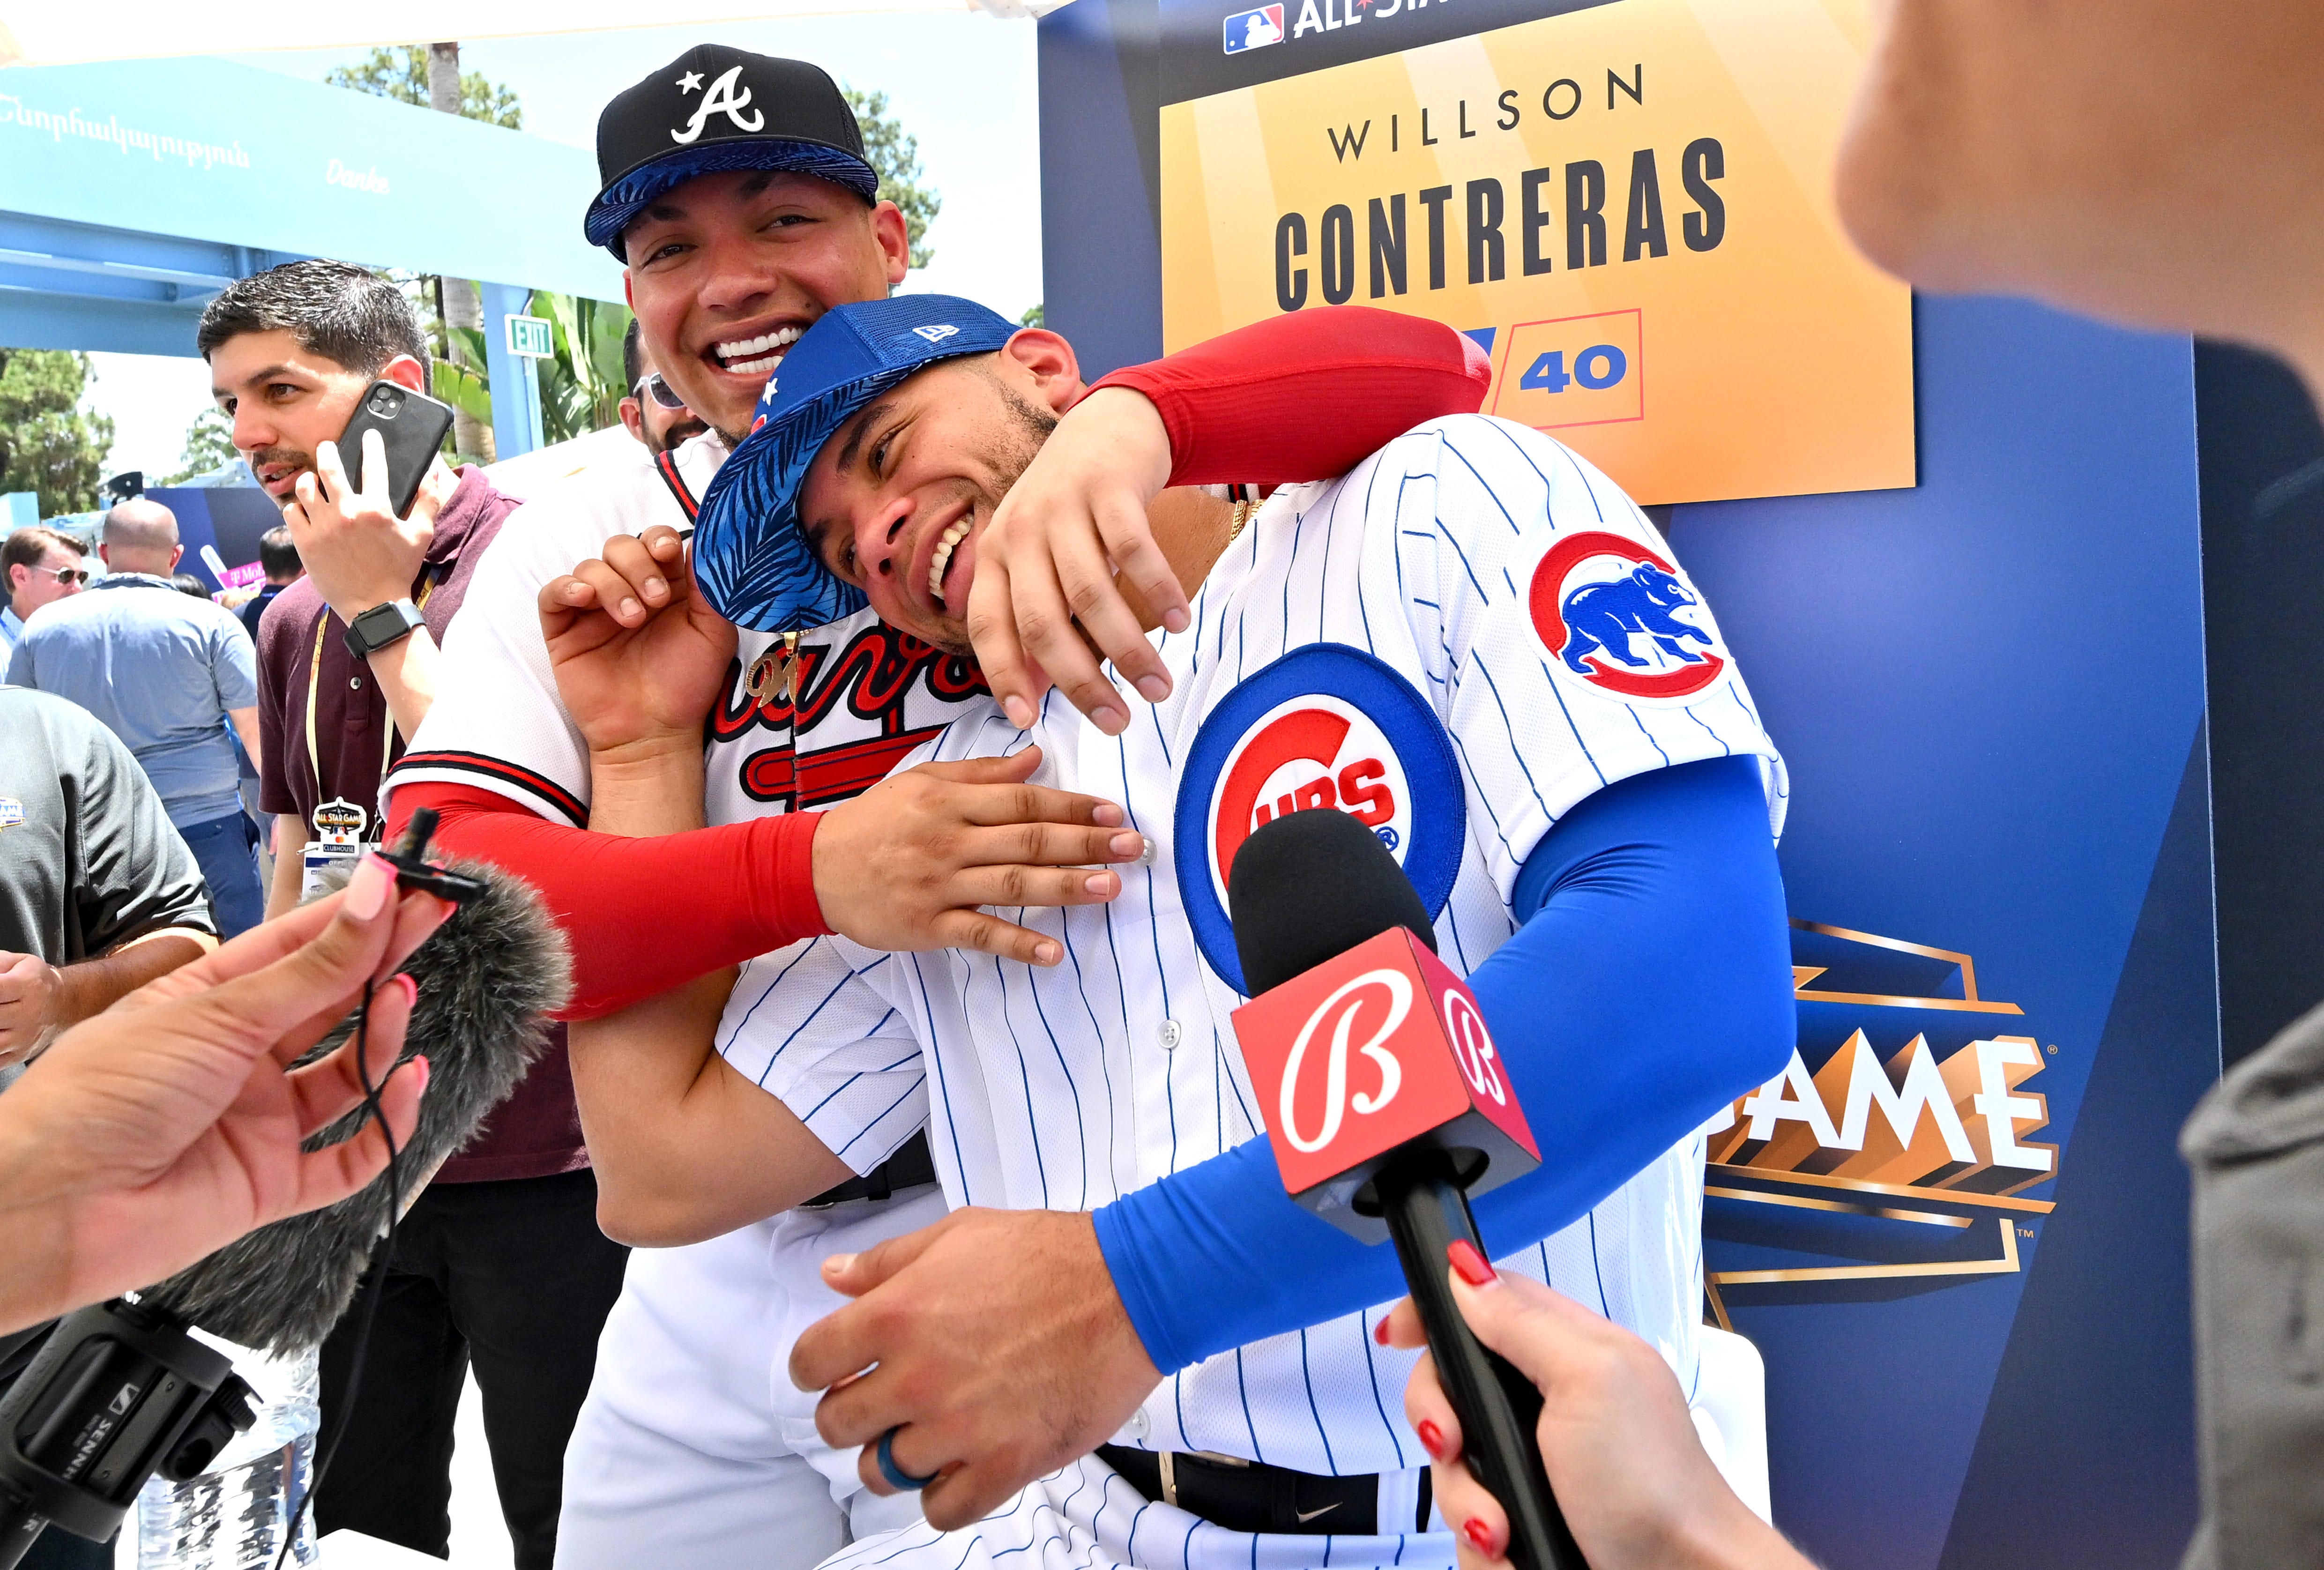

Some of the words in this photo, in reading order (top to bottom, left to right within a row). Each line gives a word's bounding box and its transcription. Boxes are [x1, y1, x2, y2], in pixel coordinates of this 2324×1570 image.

[1327, 63, 1643, 164] WILLSON
[327, 159, 391, 195] Danke
[1275, 137, 1726, 312] CONTRERAS
[515, 320, 547, 353] EXIT
[1520, 344, 1627, 394] 40
[328, 812, 343, 822] STAR
[343, 813, 362, 823] GAME
[1280, 968, 1413, 1153] B
[1706, 1027, 2052, 1172] AME
